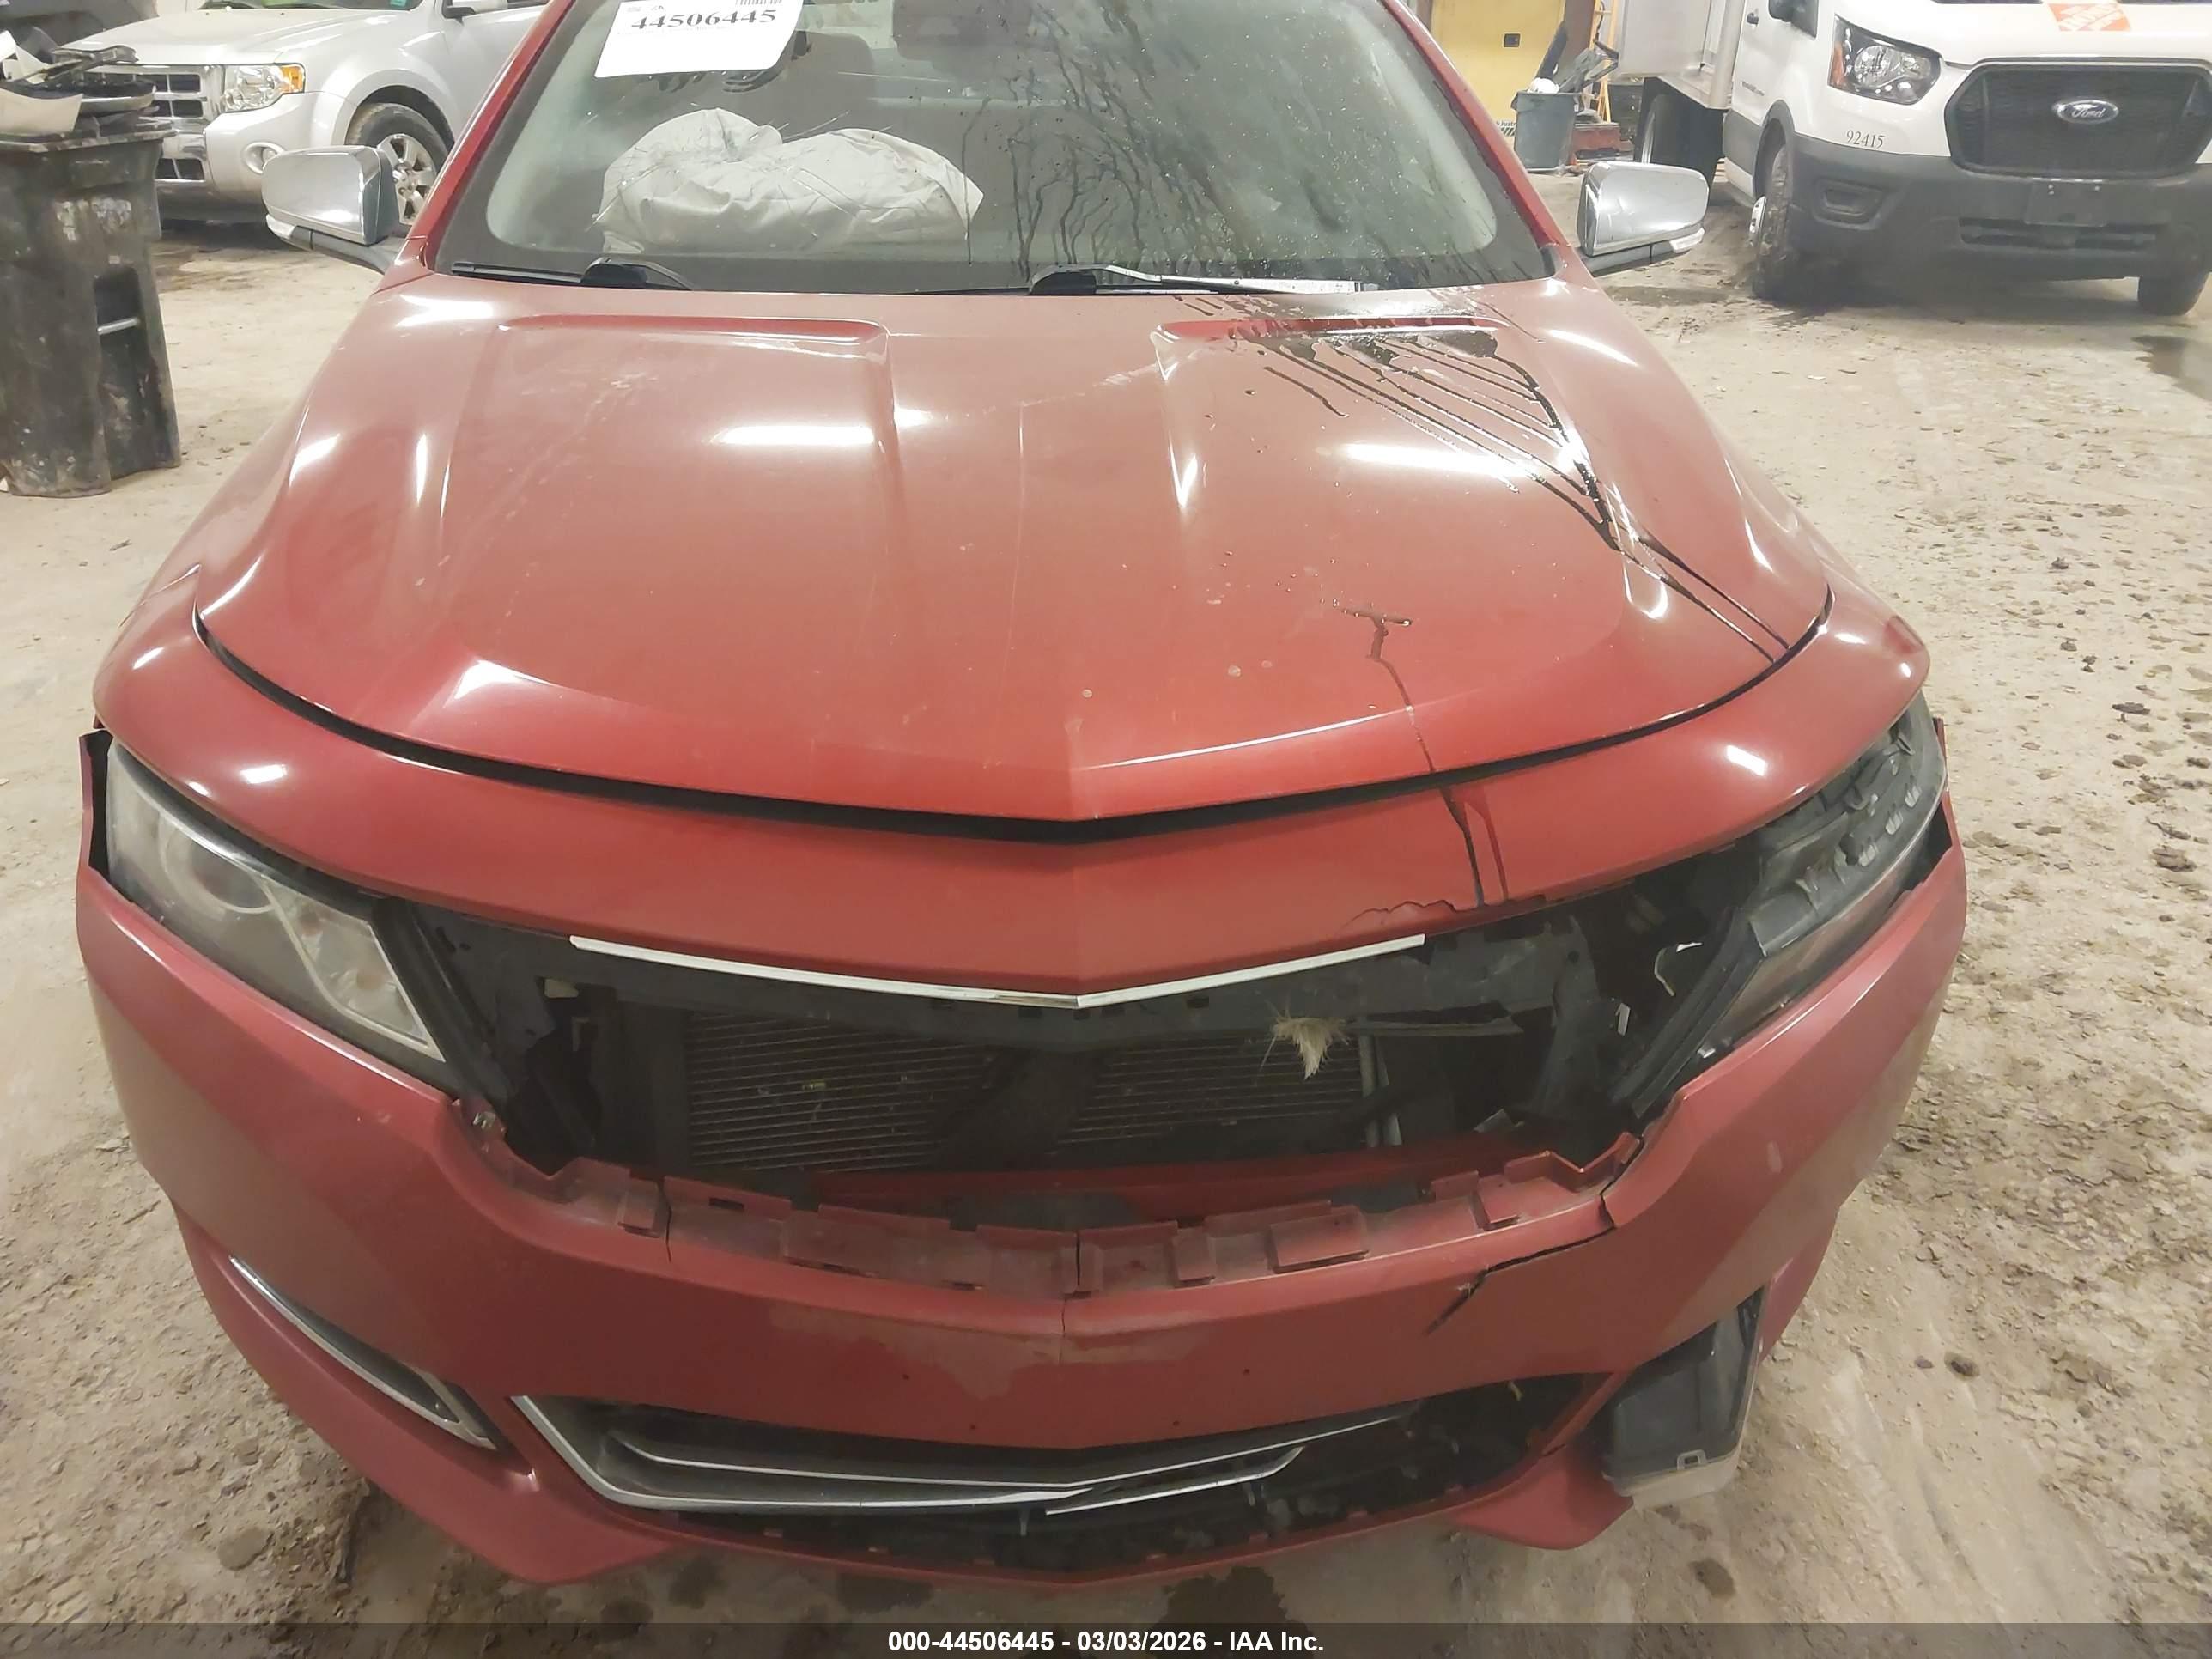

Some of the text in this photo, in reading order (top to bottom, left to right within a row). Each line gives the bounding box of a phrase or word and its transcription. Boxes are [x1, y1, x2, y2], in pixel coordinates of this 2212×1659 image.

[631, 9, 777, 30] 44506445
[2071, 103, 2106, 118] Ford
[1846, 130, 1886, 149] 92415
